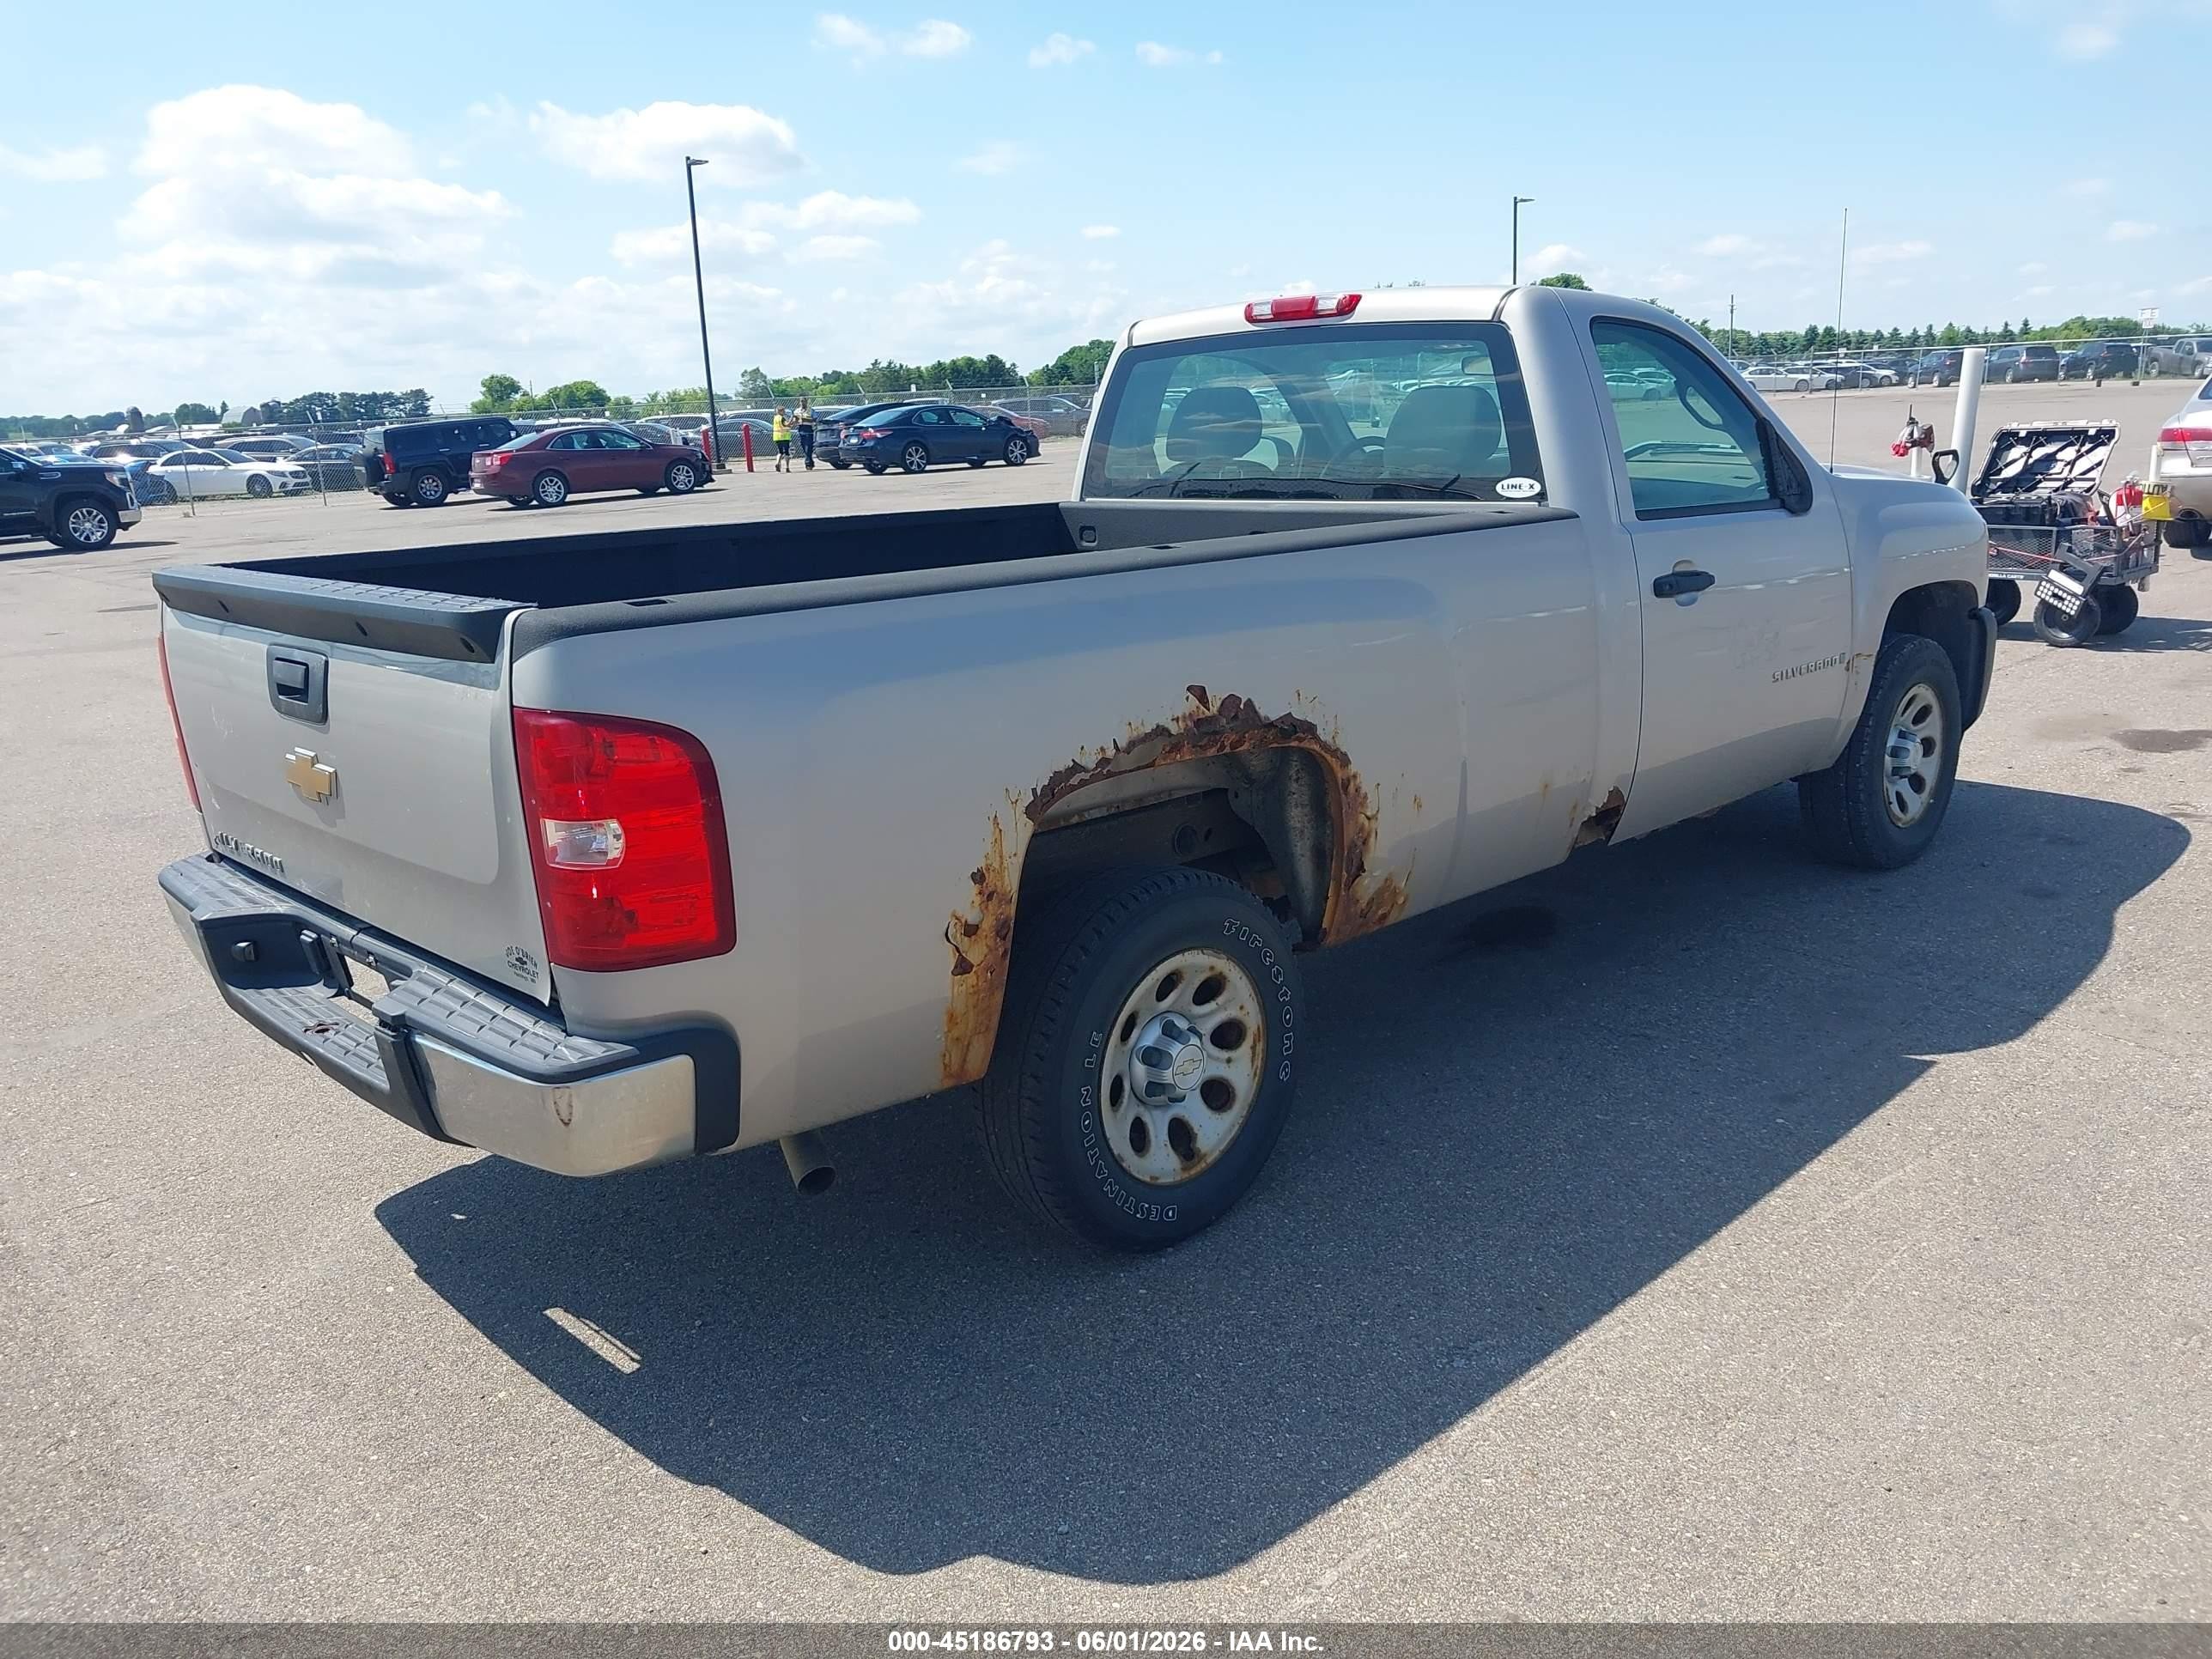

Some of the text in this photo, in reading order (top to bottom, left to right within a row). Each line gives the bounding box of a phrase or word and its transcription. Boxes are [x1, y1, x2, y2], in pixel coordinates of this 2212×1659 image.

[505, 945, 538, 970] JOE O'BRIEN
[507, 960, 539, 981] CHEVROLET
[1079, 1030, 1178, 1222] DESTINATION LE
